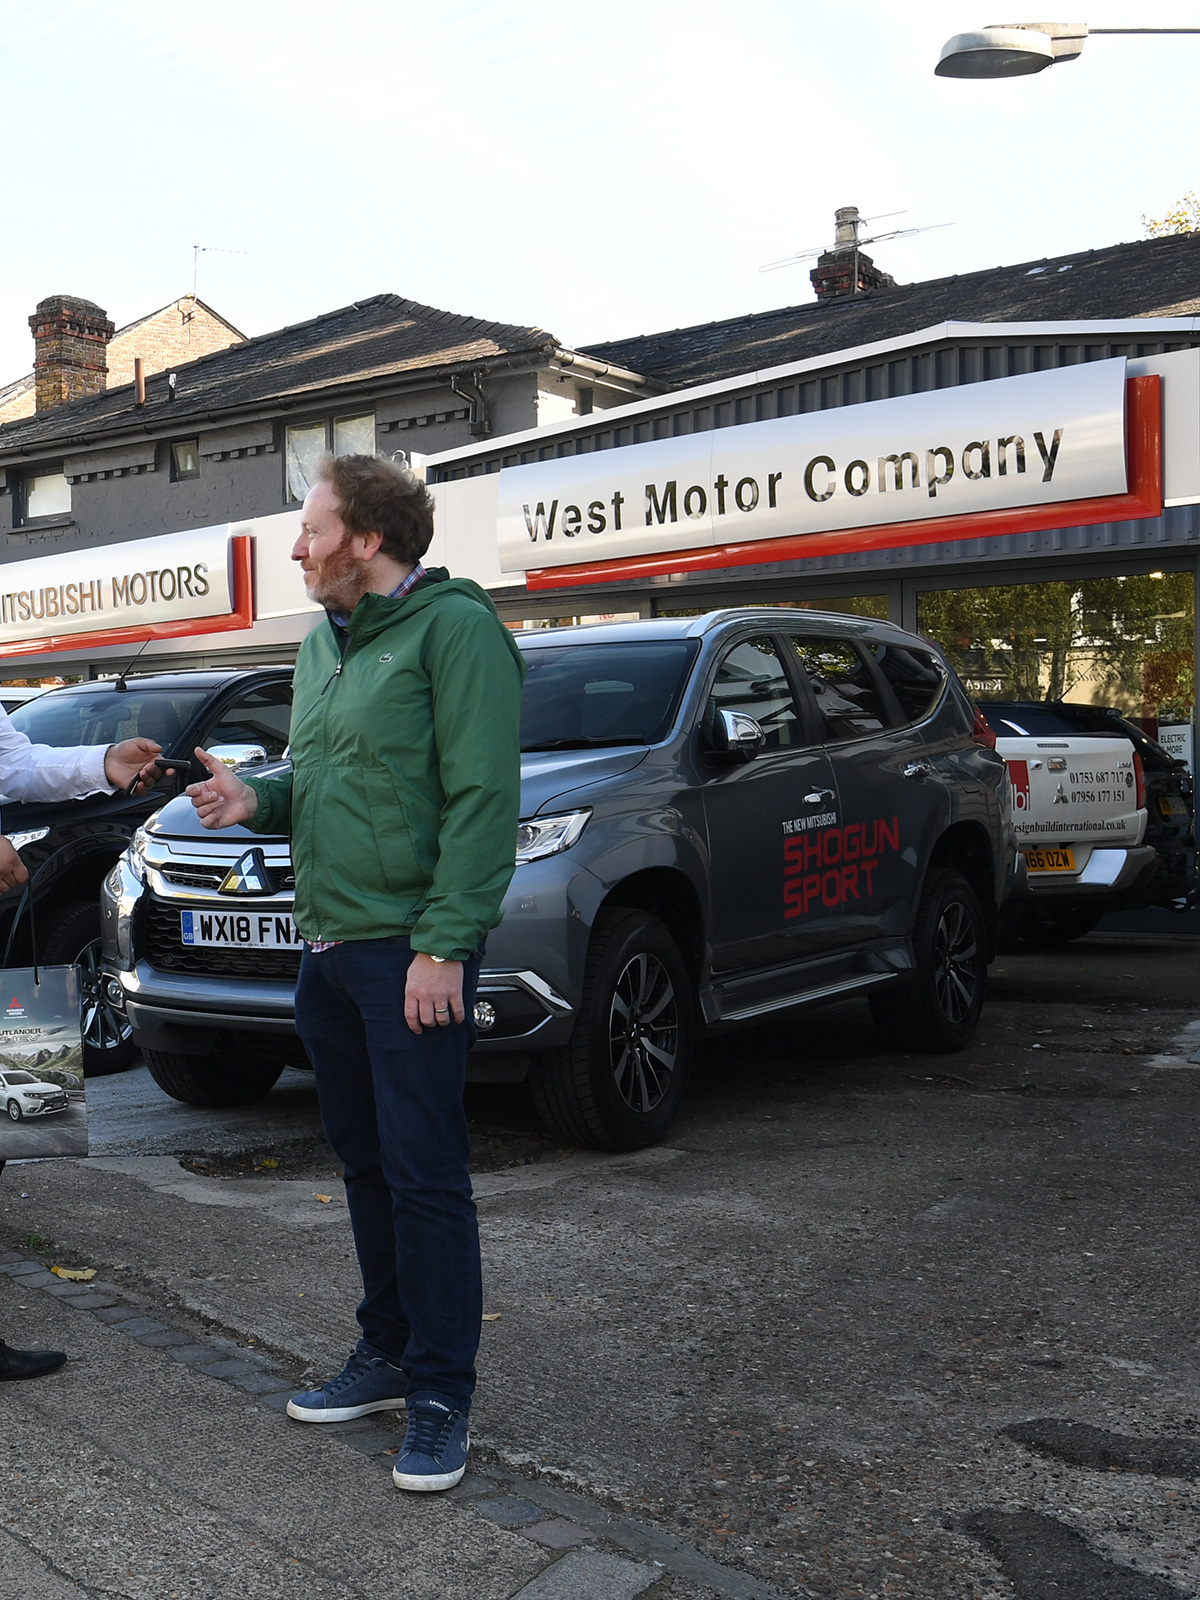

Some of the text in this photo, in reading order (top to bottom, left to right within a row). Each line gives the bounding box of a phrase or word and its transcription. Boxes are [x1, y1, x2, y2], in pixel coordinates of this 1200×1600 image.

[523, 427, 1065, 543] West Motor Company
[111, 561, 210, 609] MOTORS
[1160, 733, 1186, 744] ELECTRIC
[1166, 744, 1183, 754] MORE
[1069, 771, 1124, 784] 01753 687 717
[1071, 790, 1125, 803] 07956 177 151
[781, 811, 837, 835] THE NEW MITSUBISHI
[1011, 819, 1126, 836] esignbuildinternational.co.uk
[784, 816, 899, 876] SHOGUN
[1045, 850, 1070, 868] OZW
[783, 860, 879, 919] SPORT
[184, 932, 194, 940] GB
[200, 914, 252, 943] WX18
